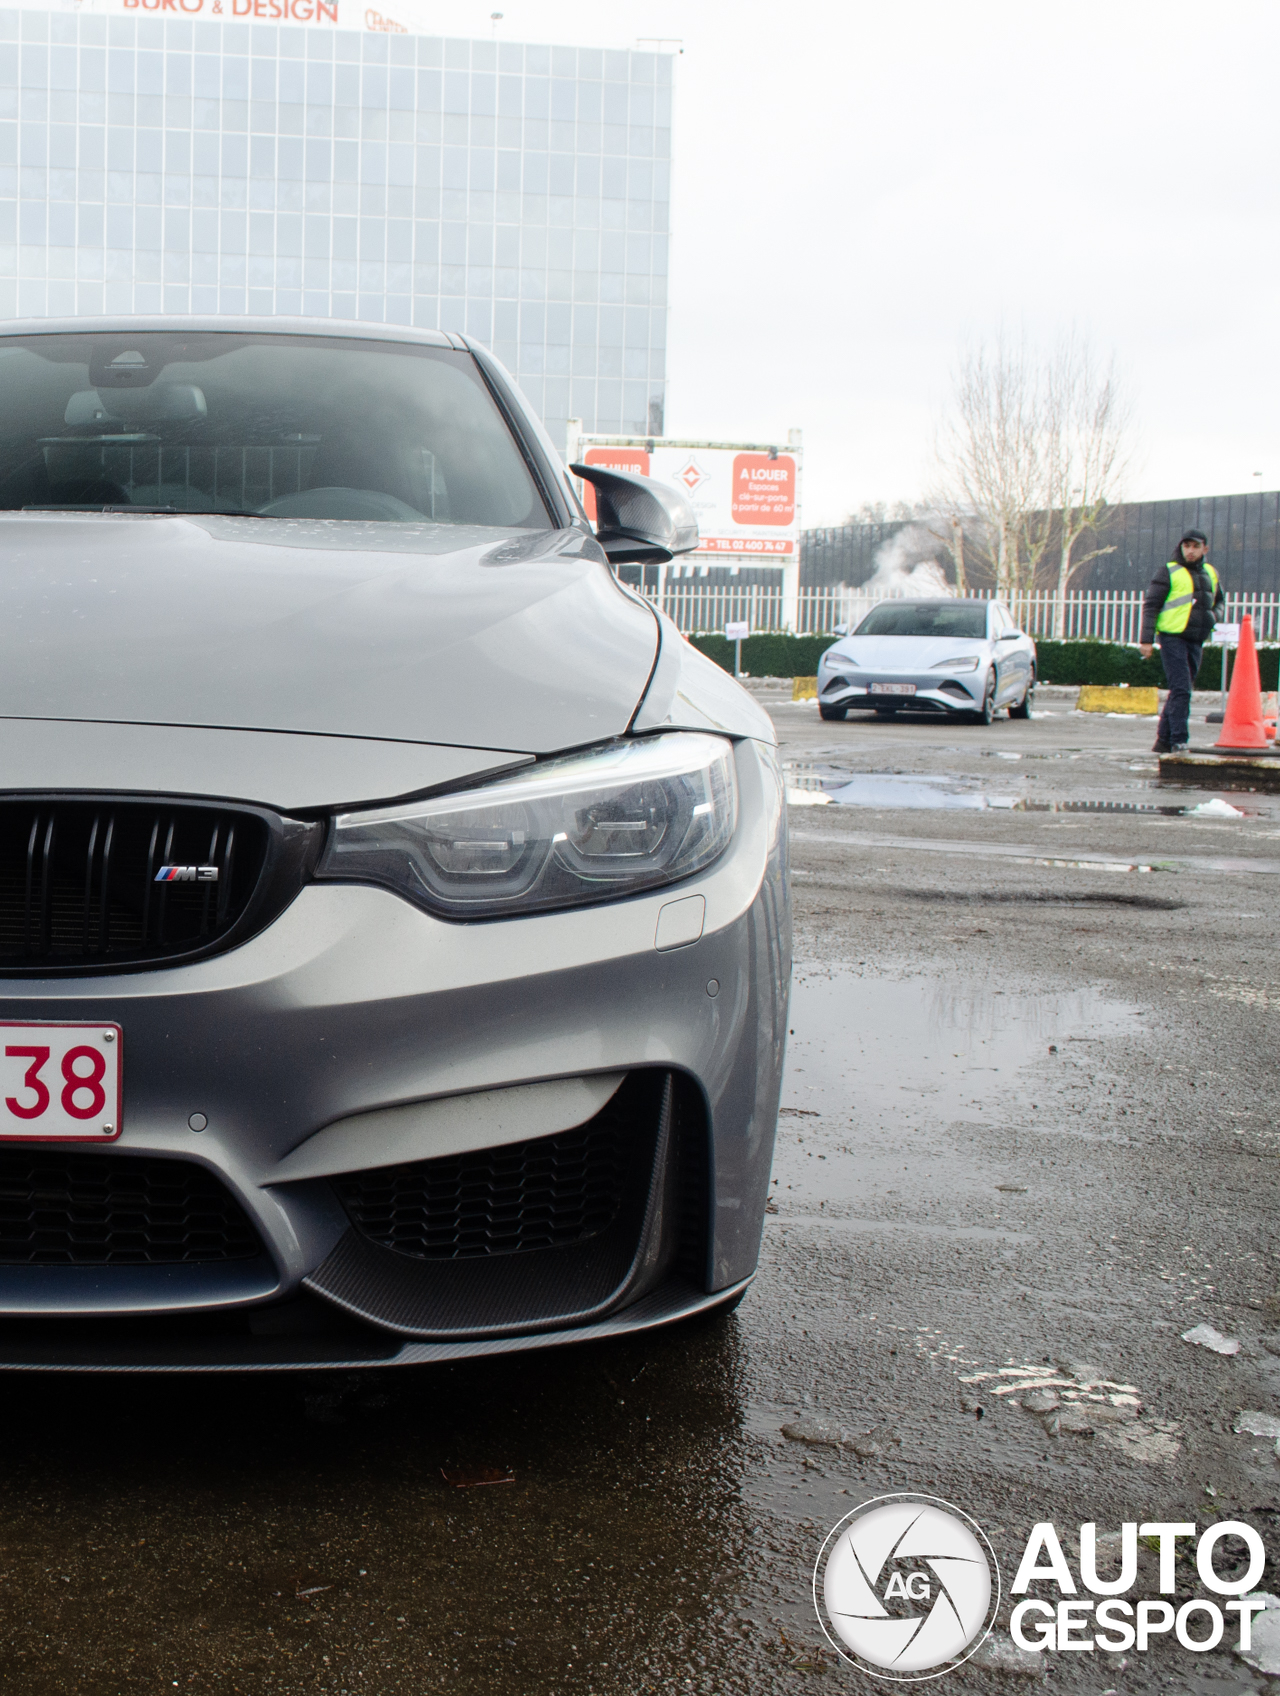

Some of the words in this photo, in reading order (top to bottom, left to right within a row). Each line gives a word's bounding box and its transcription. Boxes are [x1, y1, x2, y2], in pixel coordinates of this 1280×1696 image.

[232, 0, 338, 22] DESIGN
[740, 468, 749, 479] A
[751, 468, 788, 481] LOUER
[748, 482, 779, 491] Espaces
[738, 503, 759, 512] partir
[760, 504, 771, 512] de
[773, 504, 783, 512] 60
[716, 540, 731, 549] TEL
[732, 541, 744, 550] 02
[745, 541, 762, 550] 400
[172, 866, 219, 881] M3
